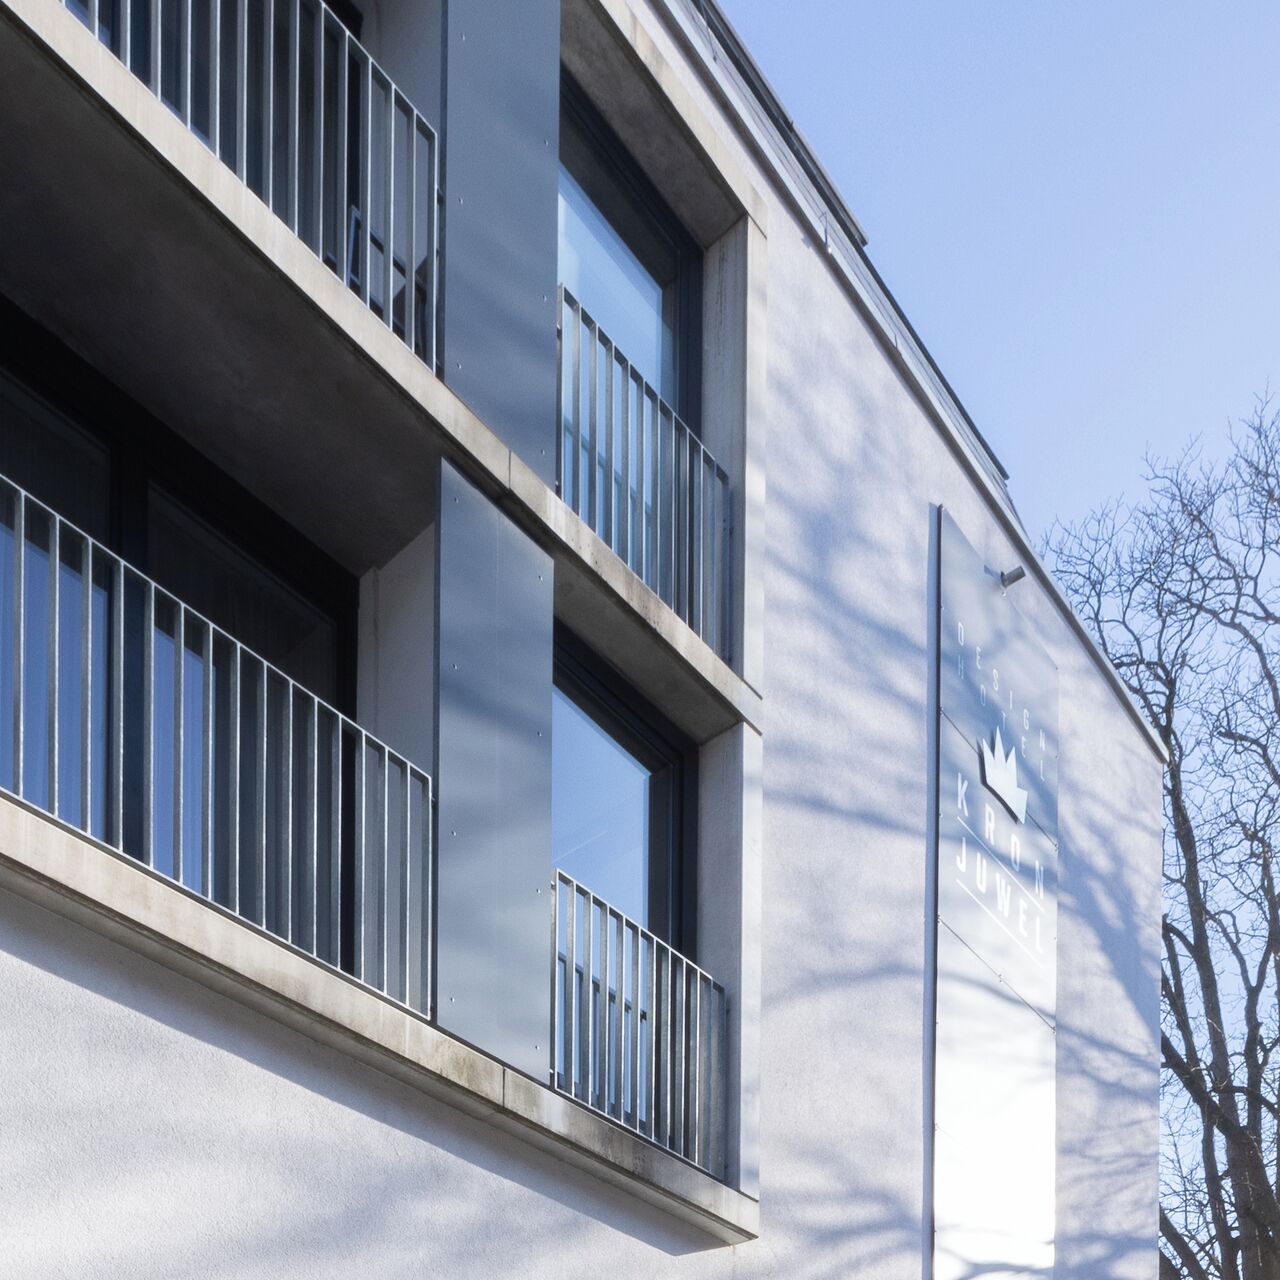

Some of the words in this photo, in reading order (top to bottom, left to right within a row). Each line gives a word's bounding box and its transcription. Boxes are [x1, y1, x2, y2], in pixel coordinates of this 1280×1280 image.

[957, 621, 1046, 752] DESIGN
[957, 654, 1046, 782] HOTEL
[955, 836, 1044, 954] JUWEL
[957, 772, 1045, 900] KRON
